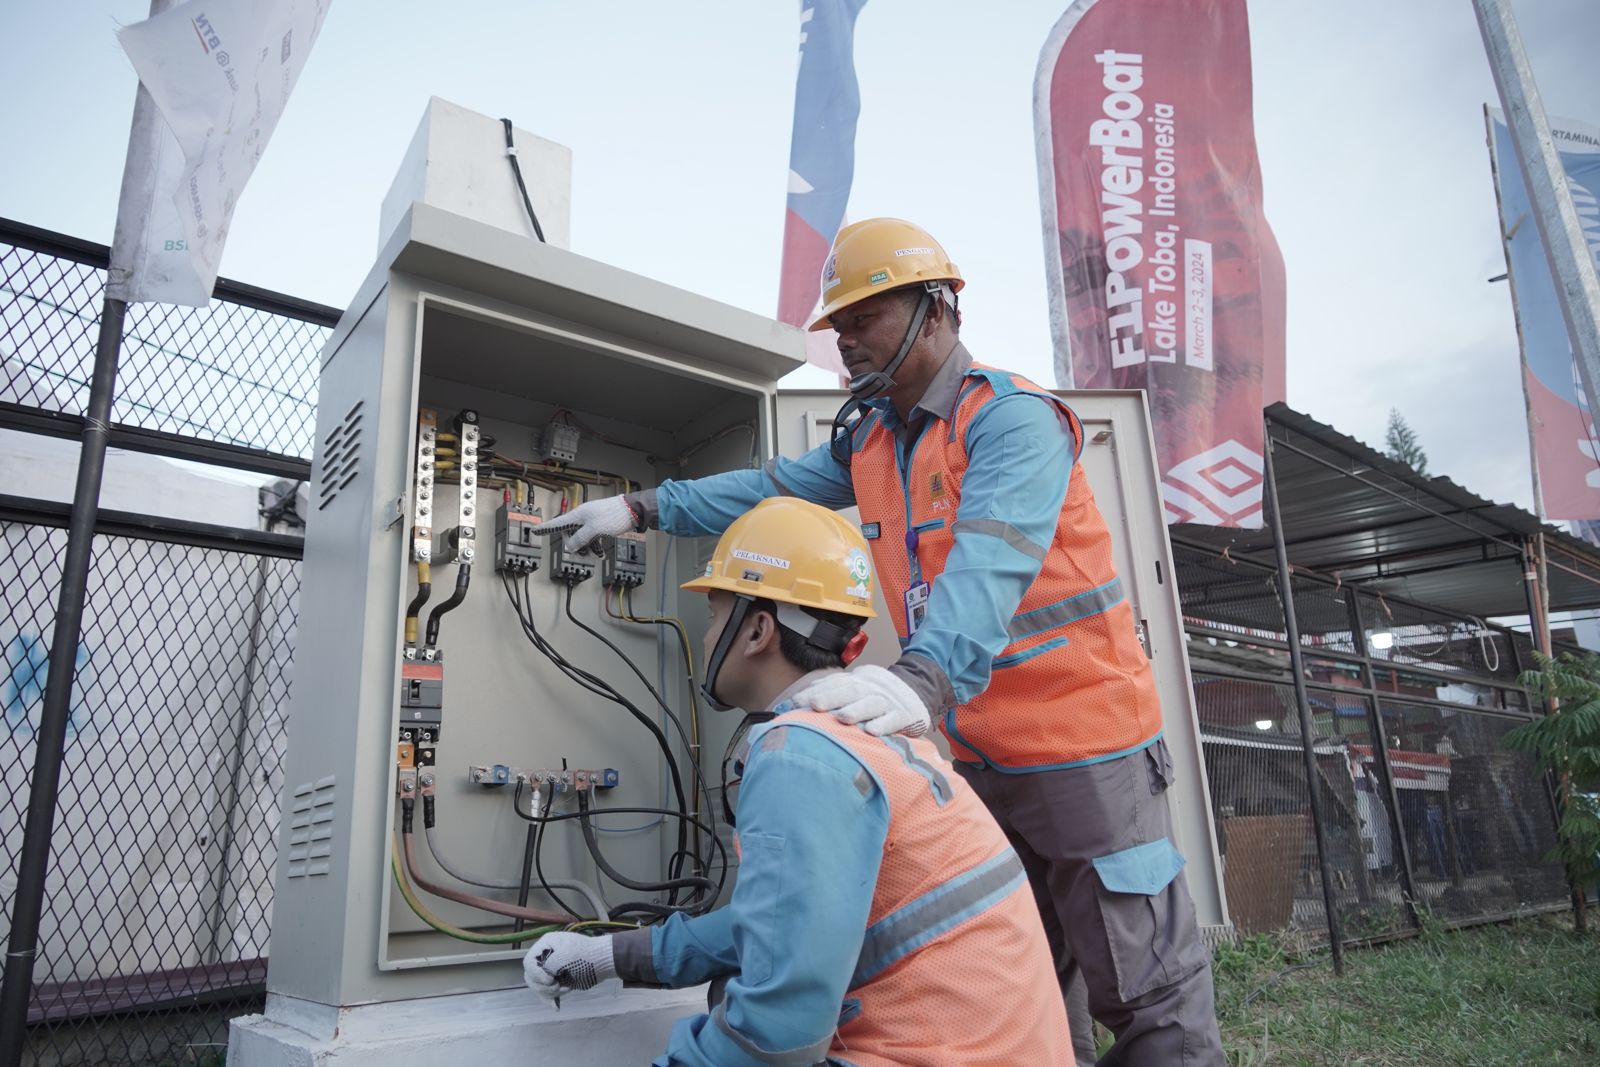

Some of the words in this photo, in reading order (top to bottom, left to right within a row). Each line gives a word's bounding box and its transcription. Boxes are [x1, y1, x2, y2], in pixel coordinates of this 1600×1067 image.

[1552, 129, 1600, 146] RTAMINA
[1147, 103, 1176, 216] Indonesia
[1148, 224, 1180, 294] Toba,
[1191, 252, 1205, 283] 2024
[871, 272, 887, 282] MSA
[1192, 287, 1206, 312] 2-3,
[1148, 300, 1176, 364] Lake
[1192, 316, 1205, 359] March
[735, 550, 788, 569] PELAKSANA
